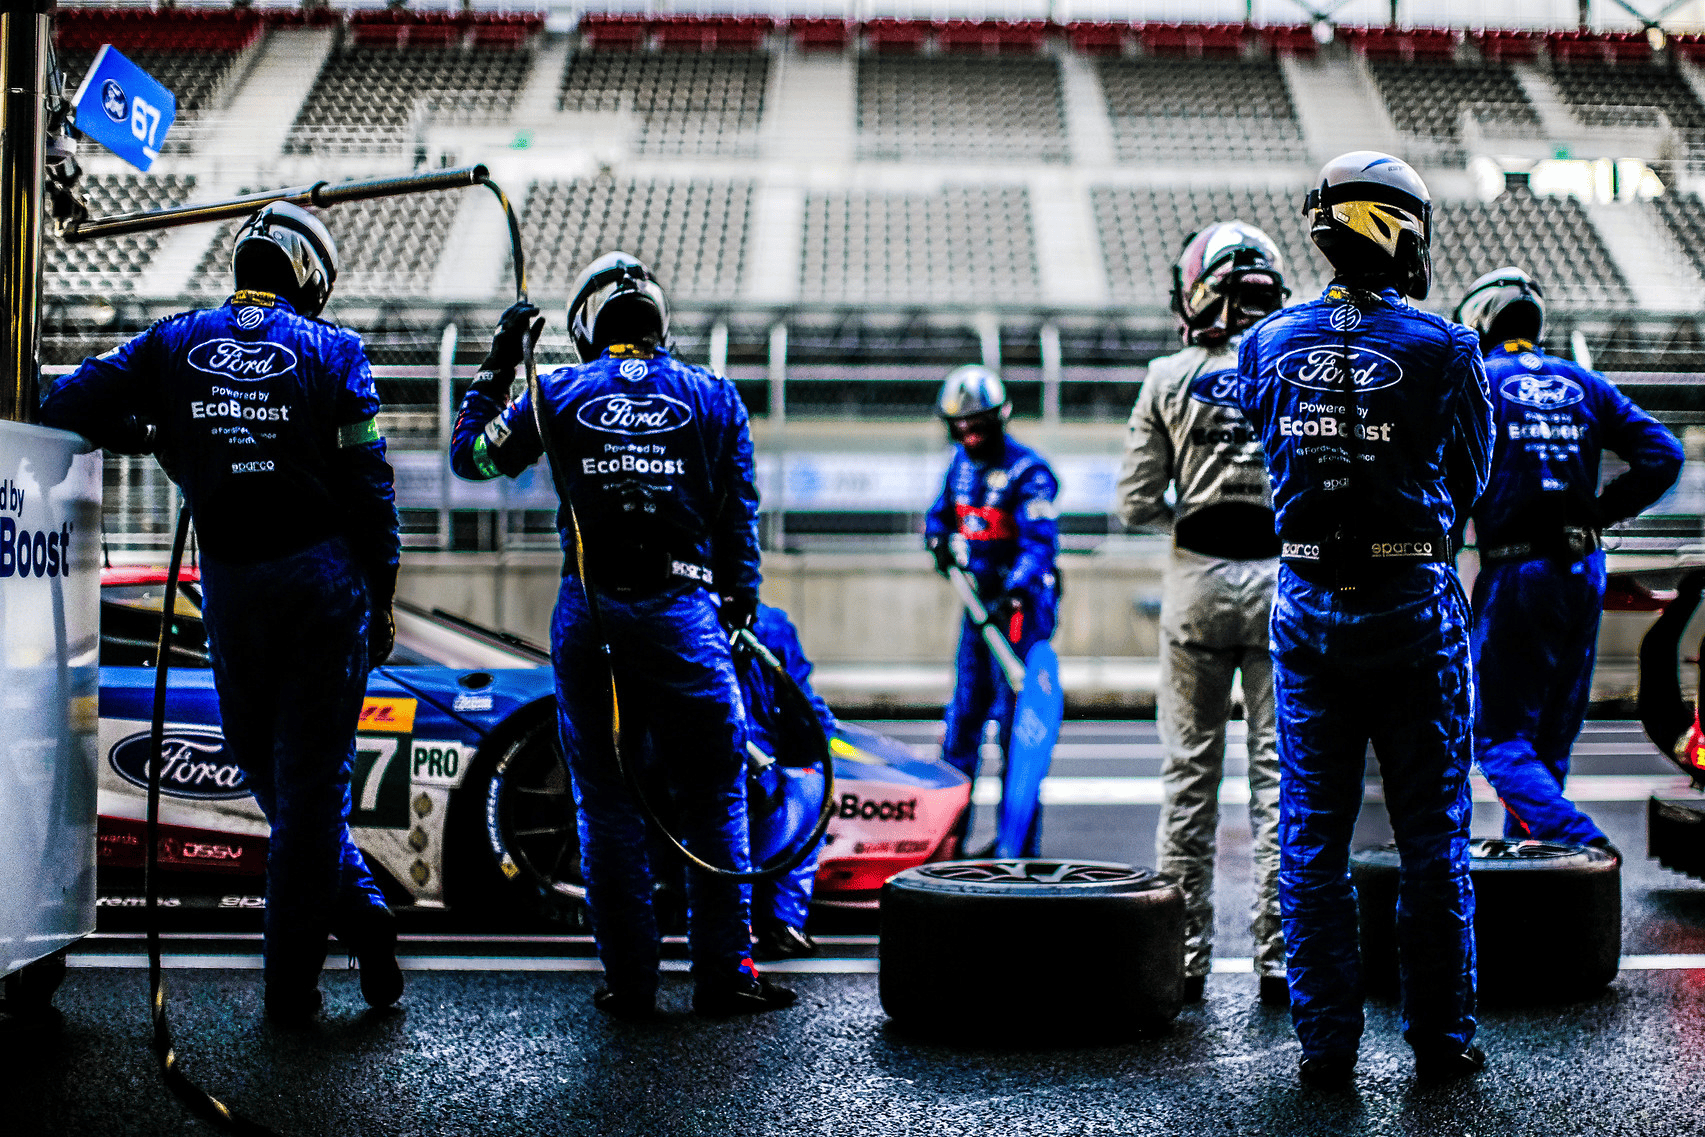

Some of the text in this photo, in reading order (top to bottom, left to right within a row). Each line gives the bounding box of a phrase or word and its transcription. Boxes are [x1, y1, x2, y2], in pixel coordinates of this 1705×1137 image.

[132, 95, 160, 147] 67
[209, 342, 275, 375] Ford
[212, 386, 270, 402] Powered by
[191, 399, 289, 421] EcoBoost
[600, 398, 669, 427] Ford
[581, 454, 686, 475] EcoBoost
[1371, 542, 1432, 557] sparco
[413, 747, 459, 777] PRO
